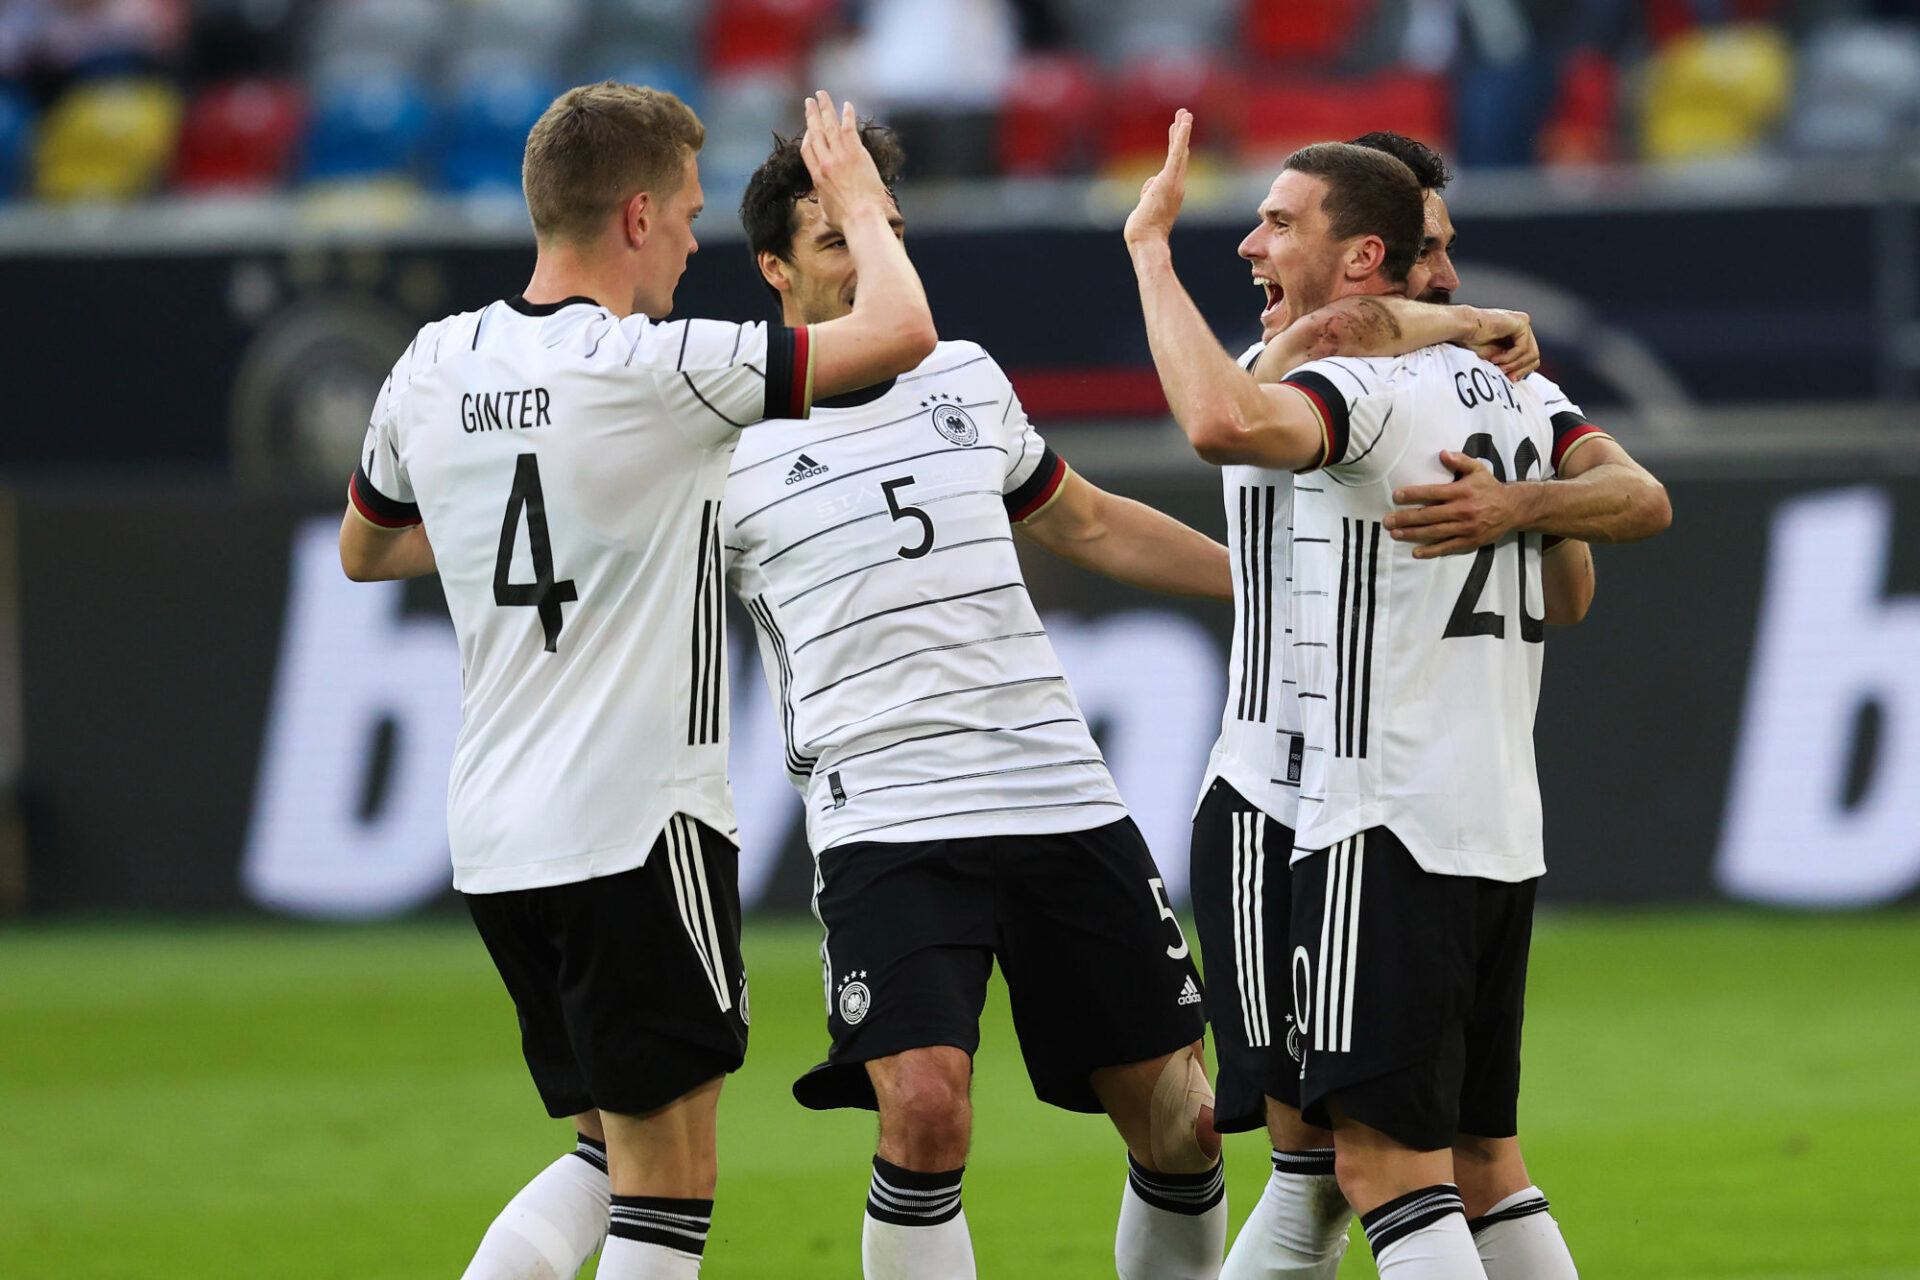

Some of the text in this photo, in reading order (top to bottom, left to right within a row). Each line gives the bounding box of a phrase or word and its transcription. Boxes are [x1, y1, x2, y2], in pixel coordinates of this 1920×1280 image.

[461, 387, 552, 434] GINTER
[784, 464, 830, 486] adidas
[492, 452, 579, 654] 4
[880, 475, 936, 560] 5
[1147, 877, 1190, 960] 5
